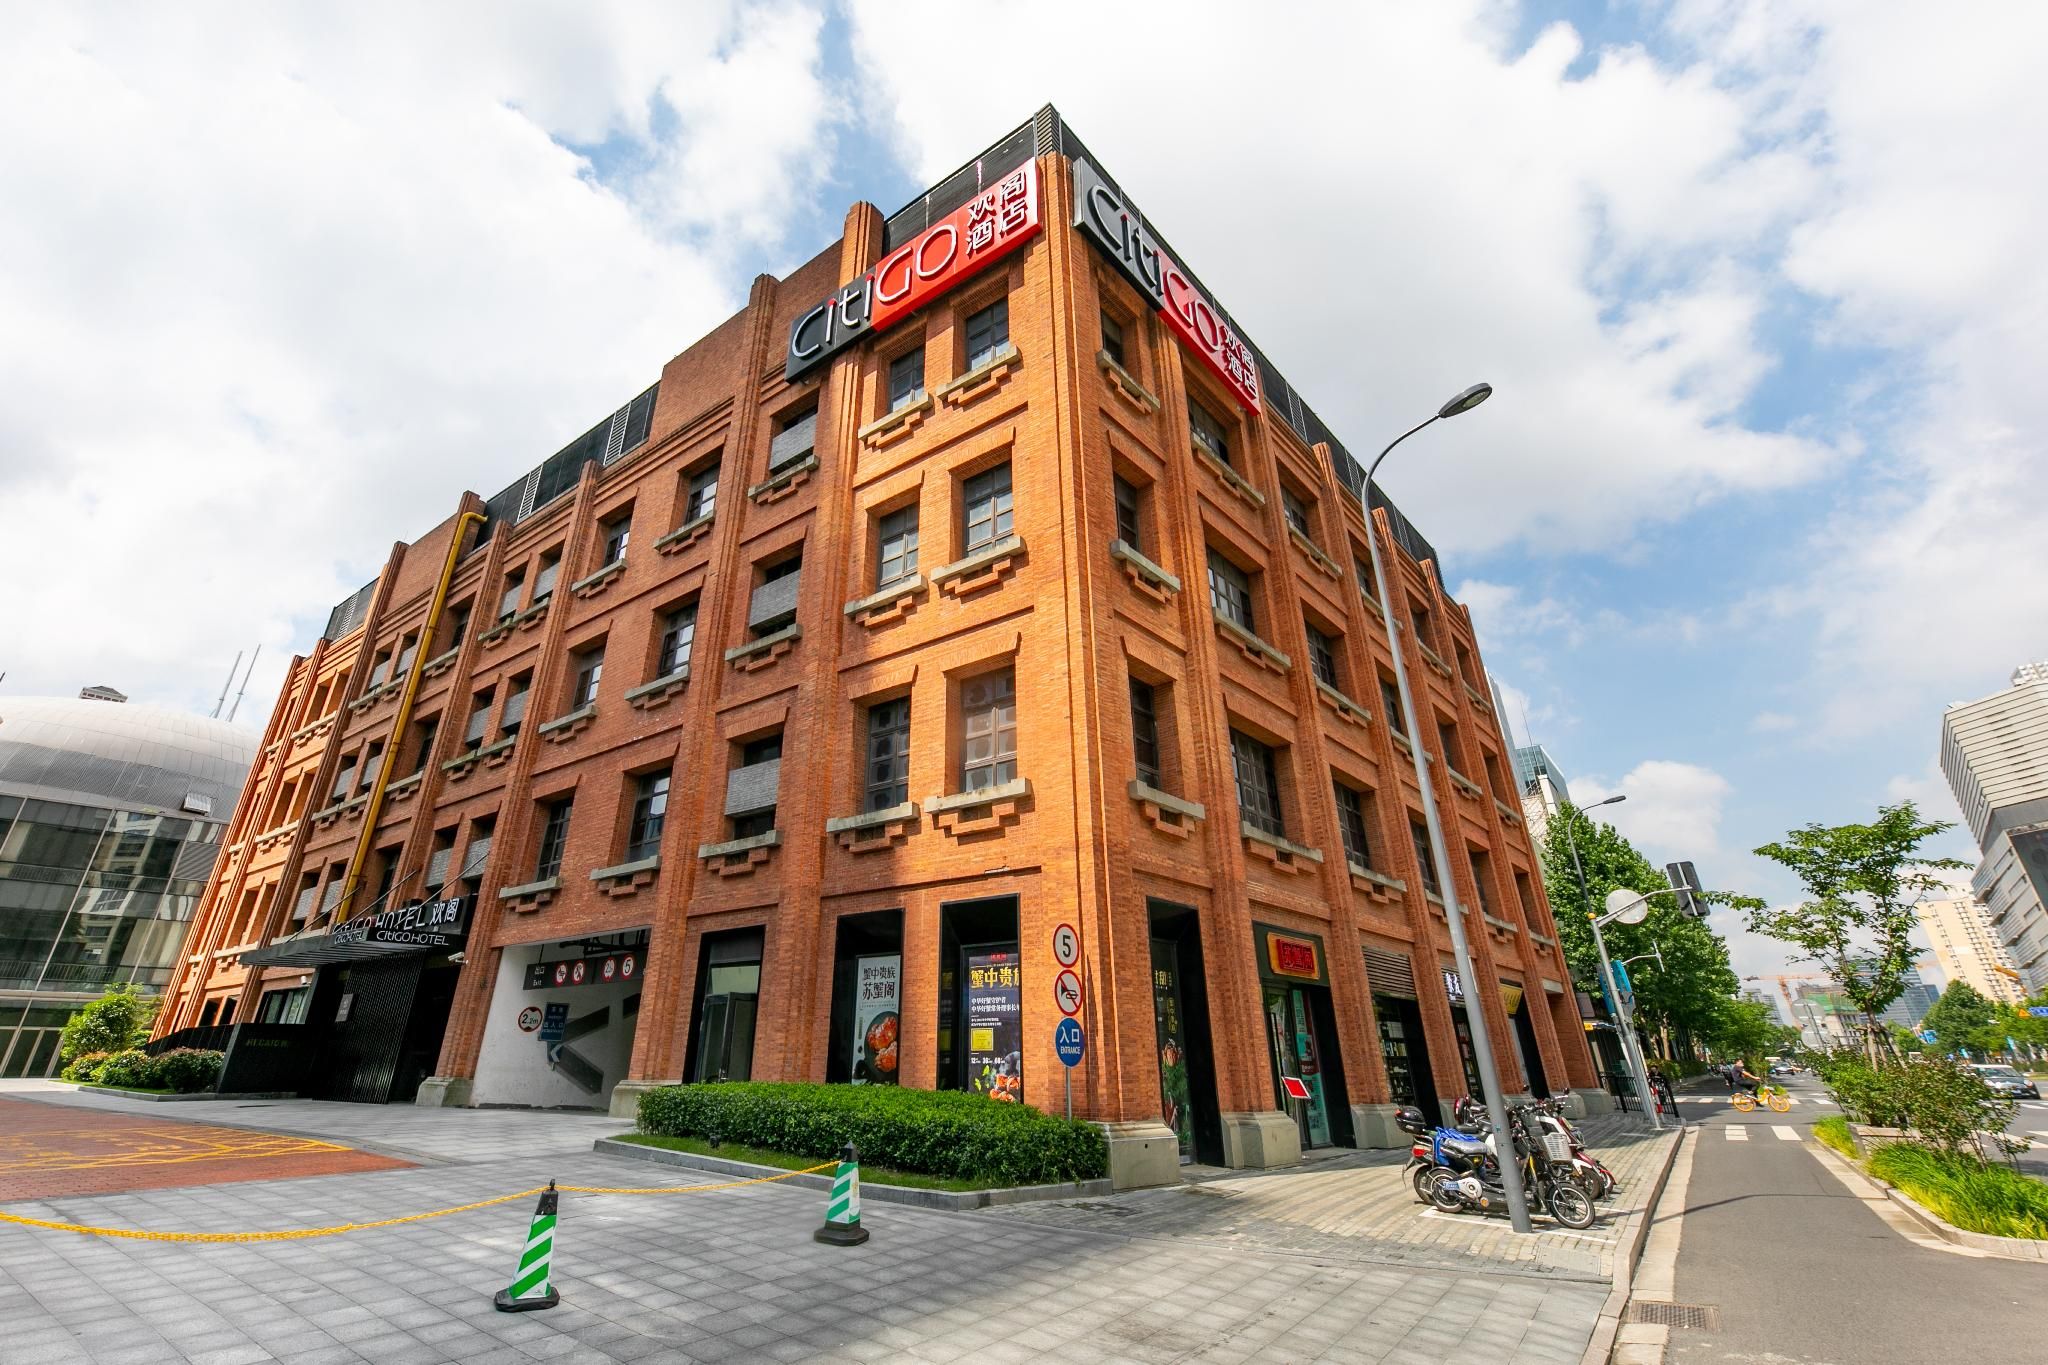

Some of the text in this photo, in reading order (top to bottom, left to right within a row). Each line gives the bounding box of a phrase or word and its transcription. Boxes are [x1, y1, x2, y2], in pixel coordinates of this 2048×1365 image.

[967, 169, 1026, 228] 欢阁
[965, 198, 1027, 255] 酒店
[1062, 935, 1071, 958] 5
[624, 959, 631, 974] 5
[864, 966, 896, 980] 蟹中贵族
[863, 981, 895, 1000] 苏蟹阁
[1060, 1026, 1080, 1043] 入口
[1061, 1046, 1080, 1055] ENTRANCE
